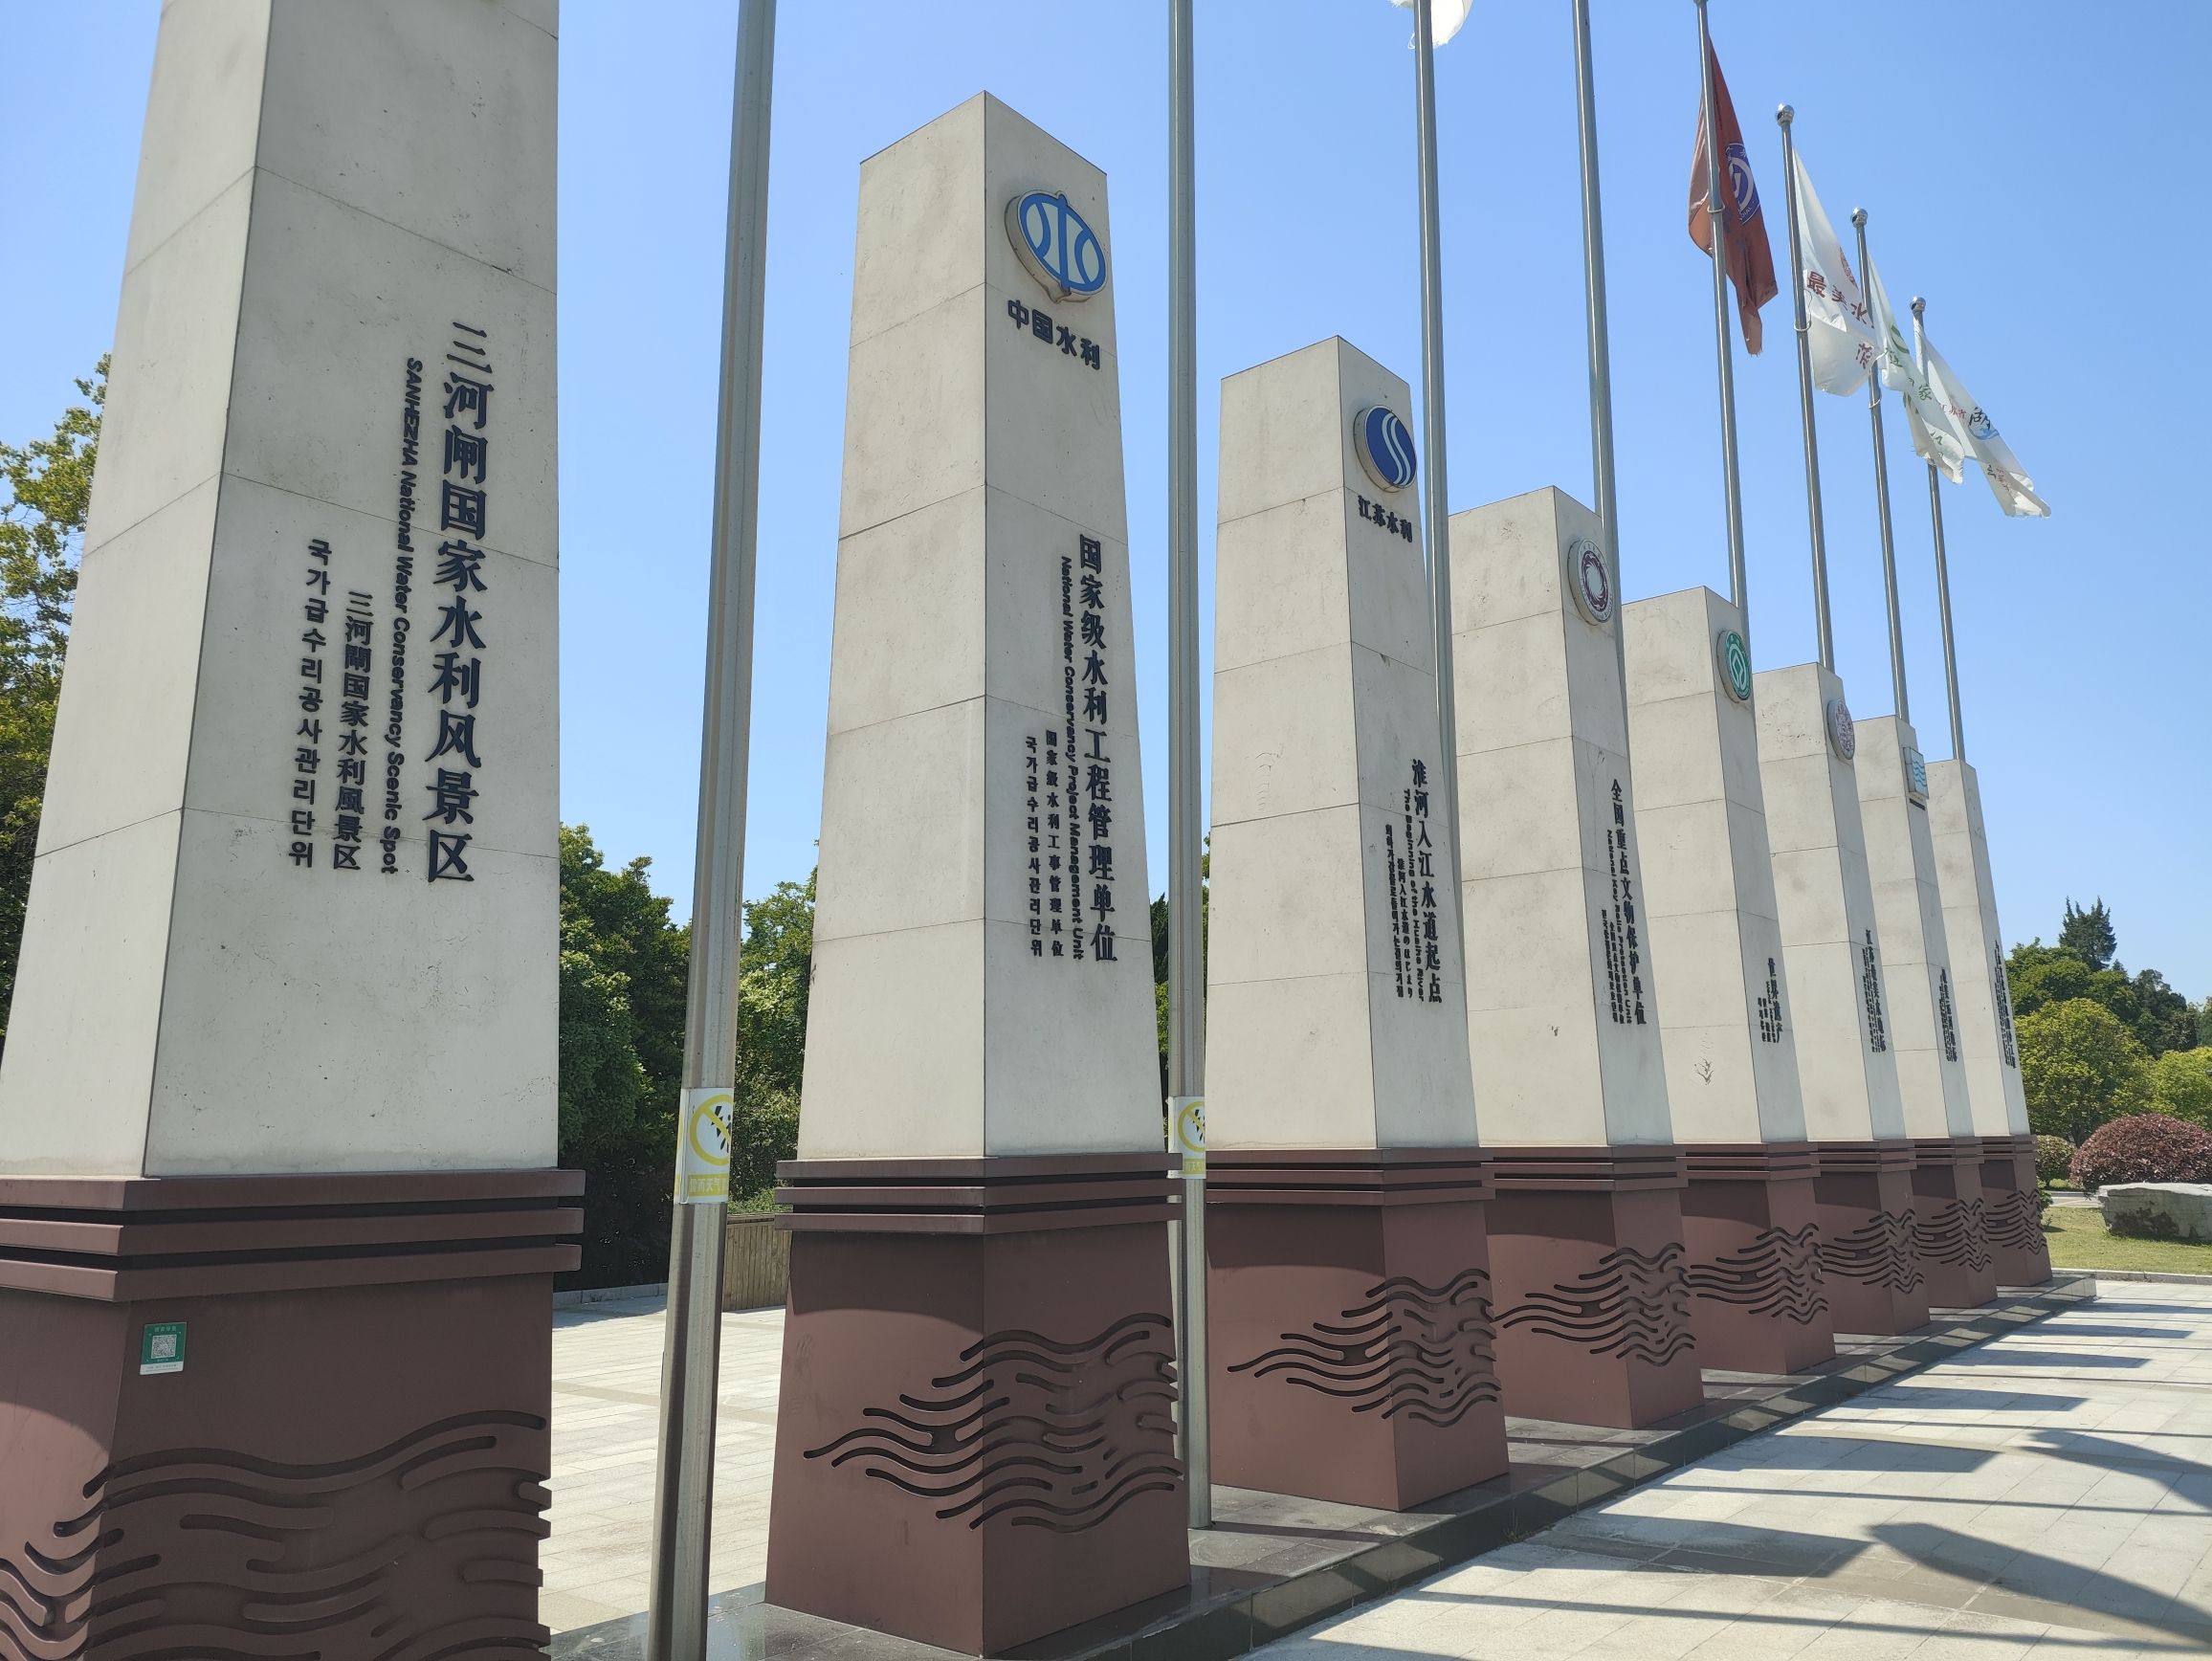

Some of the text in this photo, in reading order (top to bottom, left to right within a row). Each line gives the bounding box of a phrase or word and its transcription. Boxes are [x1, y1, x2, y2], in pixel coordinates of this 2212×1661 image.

[1007, 299, 1100, 370] 中国水利
[380, 358, 423, 874] SANHEZHA National Water Conservancy Scenic Spot
[422, 322, 494, 882] 三河闸国家水利风景区
[1358, 495, 1412, 543] 江苏水利
[289, 539, 332, 868] 국가급수리공사관리단위
[1026, 736, 1042, 957] 국가급수리공사관리단위
[1061, 556, 1084, 960] National Water Conservancy Project Management Unit
[1079, 534, 1117, 962] 国家级水利工程管理单位
[1412, 759, 1442, 1003] 淮河入江水道起点
[1611, 779, 1647, 1024] 全国重点文物保护单位
